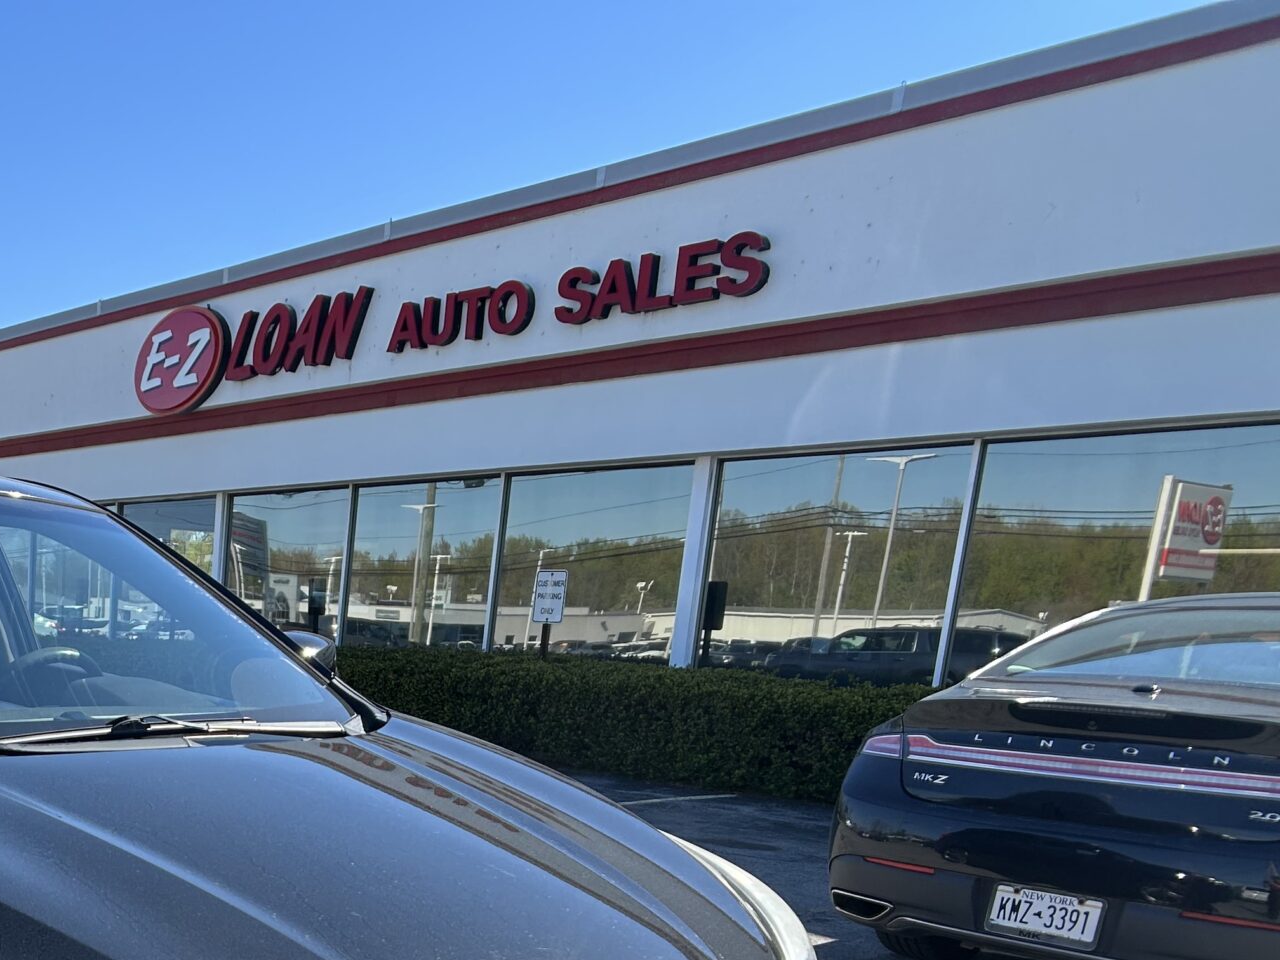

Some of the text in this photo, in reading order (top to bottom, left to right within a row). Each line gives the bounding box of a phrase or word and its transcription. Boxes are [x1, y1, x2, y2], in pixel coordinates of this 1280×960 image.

[139, 231, 770, 392] E-Z LOAN AUTO SALES
[974, 733, 1230, 767] LINCOLN
[913, 772, 949, 784] MKZ
[1021, 890, 1076, 908] NEW YORK
